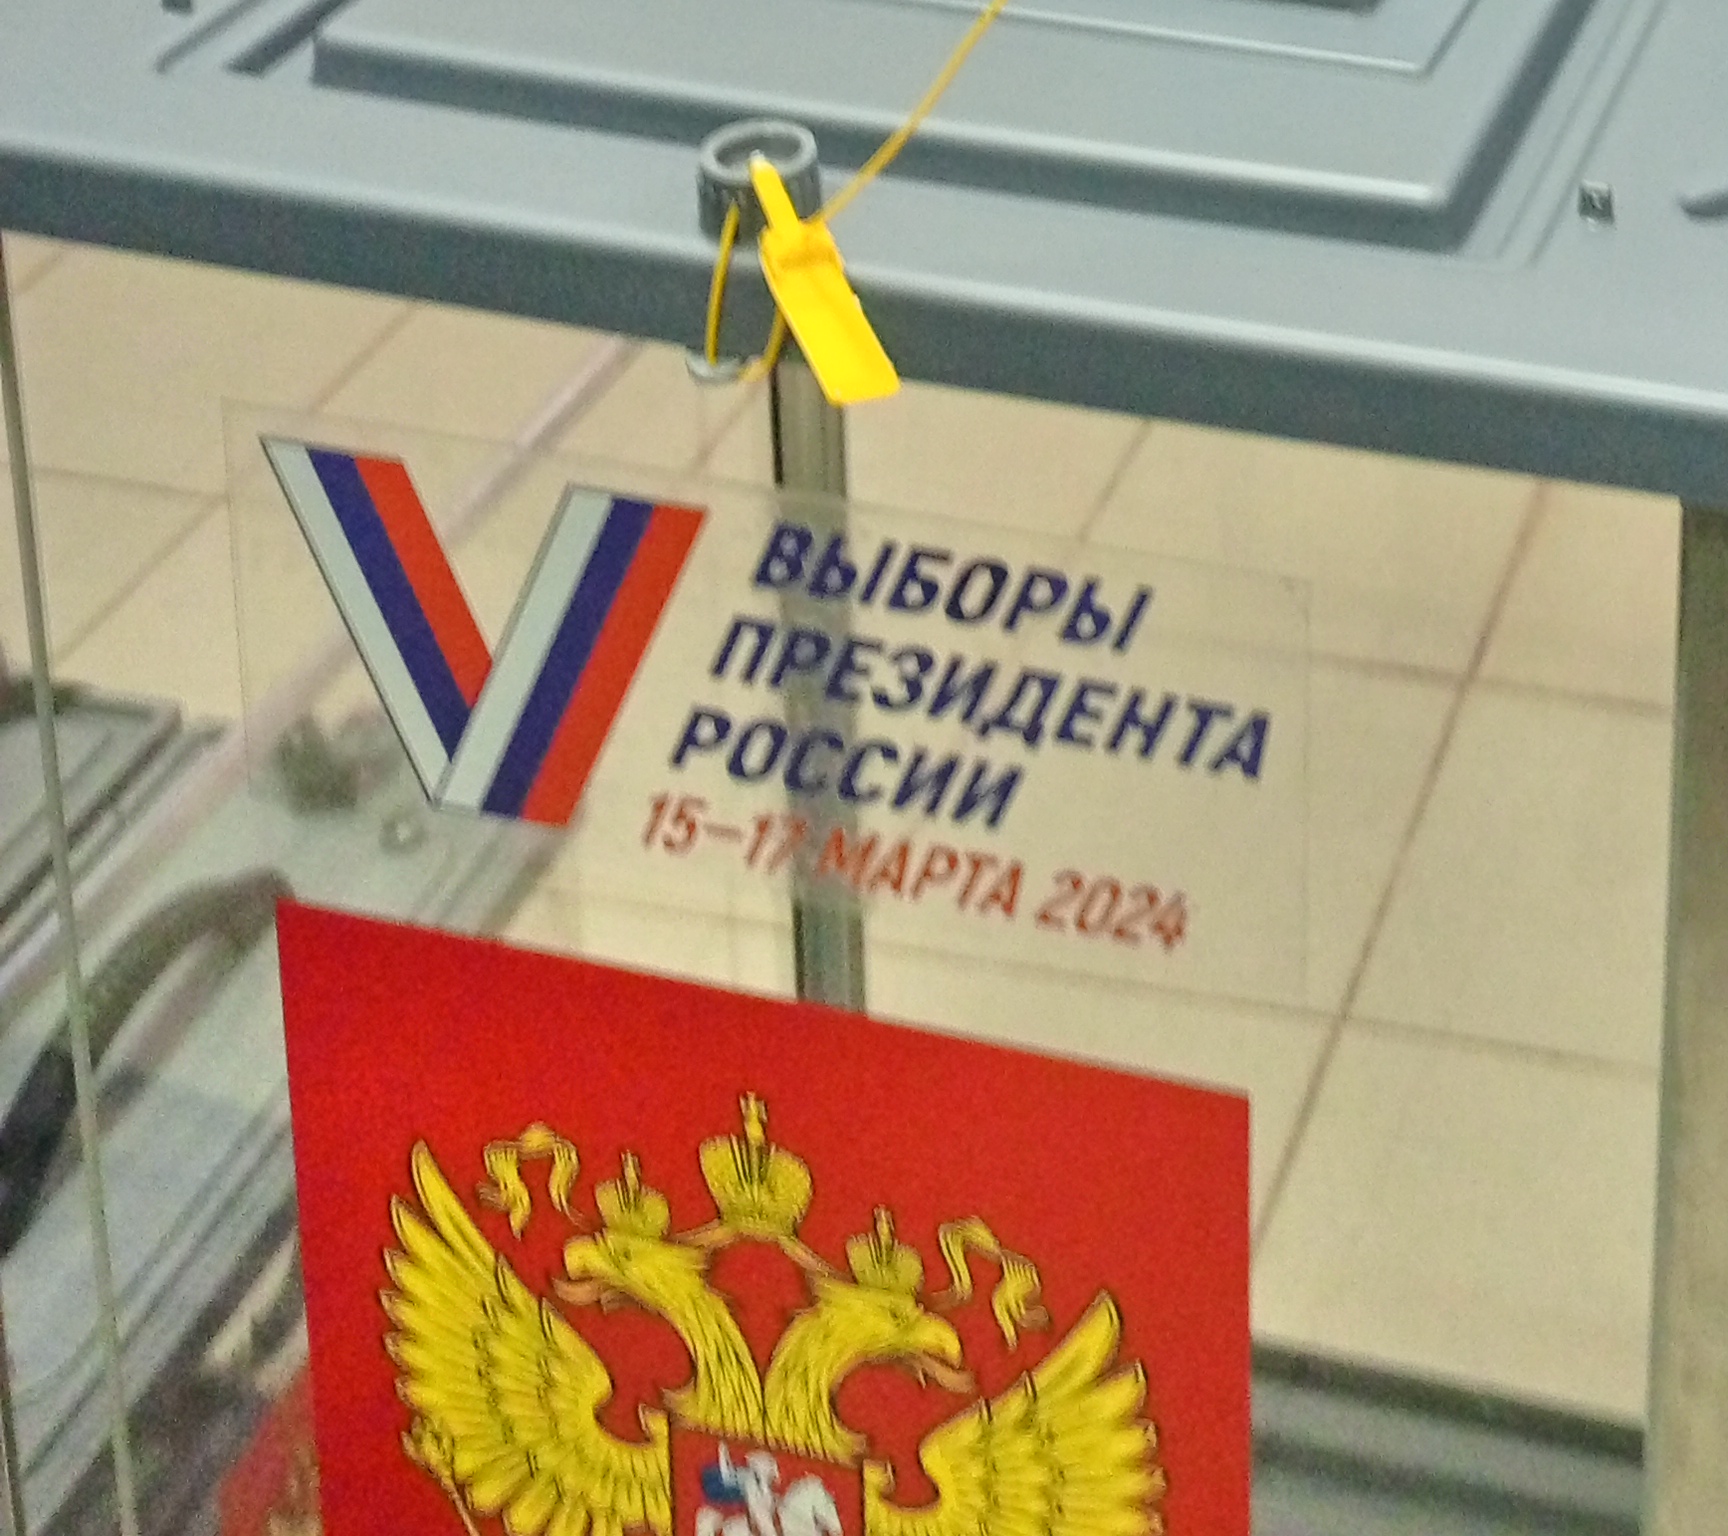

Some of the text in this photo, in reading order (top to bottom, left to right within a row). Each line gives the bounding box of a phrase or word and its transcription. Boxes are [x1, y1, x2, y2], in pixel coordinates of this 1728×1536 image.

[752, 522, 1154, 655] ВЫБОРЫ
[708, 613, 1273, 783] ПРЕЗИДЕНТА
[668, 704, 1024, 828] РОССИИ
[815, 826, 1025, 918] МАРТА
[1033, 869, 1191, 955] 2024
